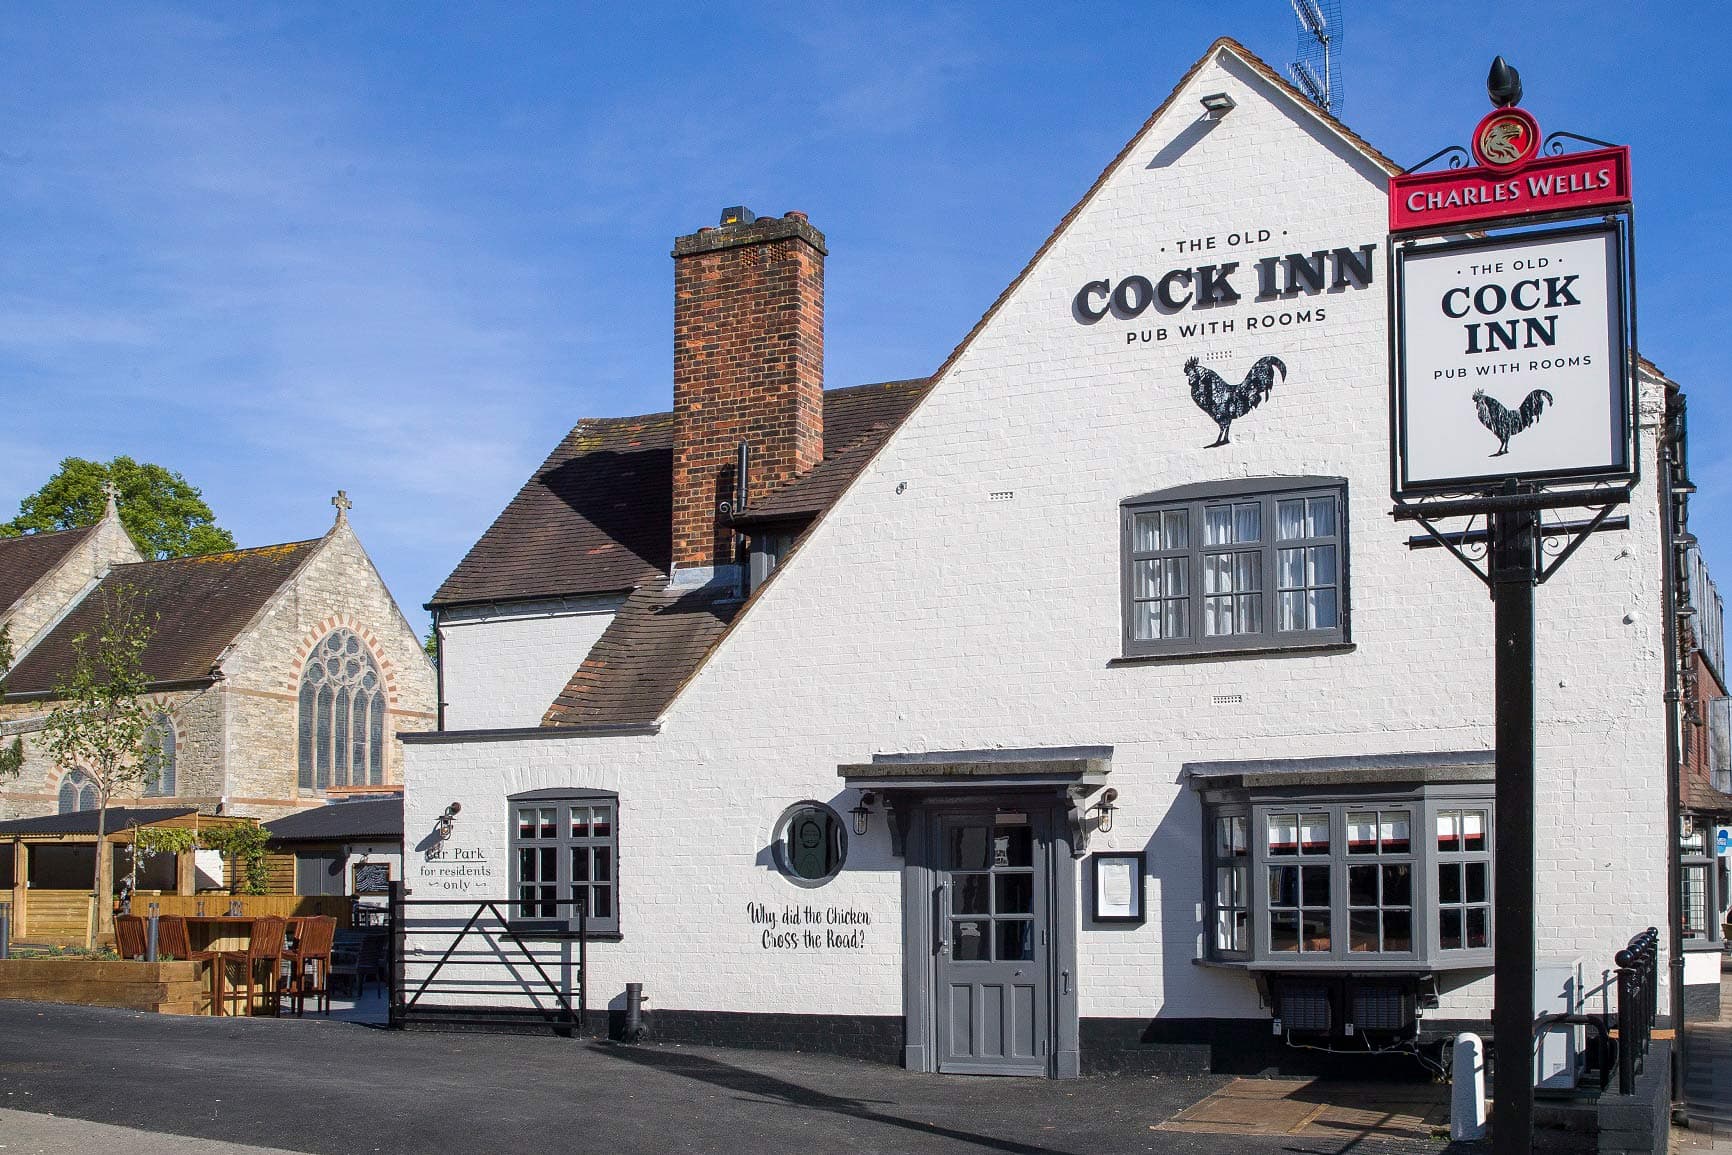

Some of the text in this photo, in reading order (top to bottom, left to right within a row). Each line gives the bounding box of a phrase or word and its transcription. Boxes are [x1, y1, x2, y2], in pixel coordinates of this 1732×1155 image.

[1406, 168, 1611, 213] CHARLES WELLS
[1176, 229, 1271, 254] THE OLD
[1470, 257, 1549, 276] THE OLD
[1074, 243, 1377, 322] COCK INN
[1441, 274, 1581, 319] COCK
[1126, 308, 1327, 345] PUB WITH ROOMS
[1464, 315, 1559, 355] INN
[1434, 355, 1593, 380] PUB WITH ROOMS
[454, 847, 485, 860] Park
[420, 865, 491, 877] for residents
[443, 879, 470, 892] only
[747, 901, 871, 930] Why did the Chicken
[762, 928, 865, 949] Cross the Road?
